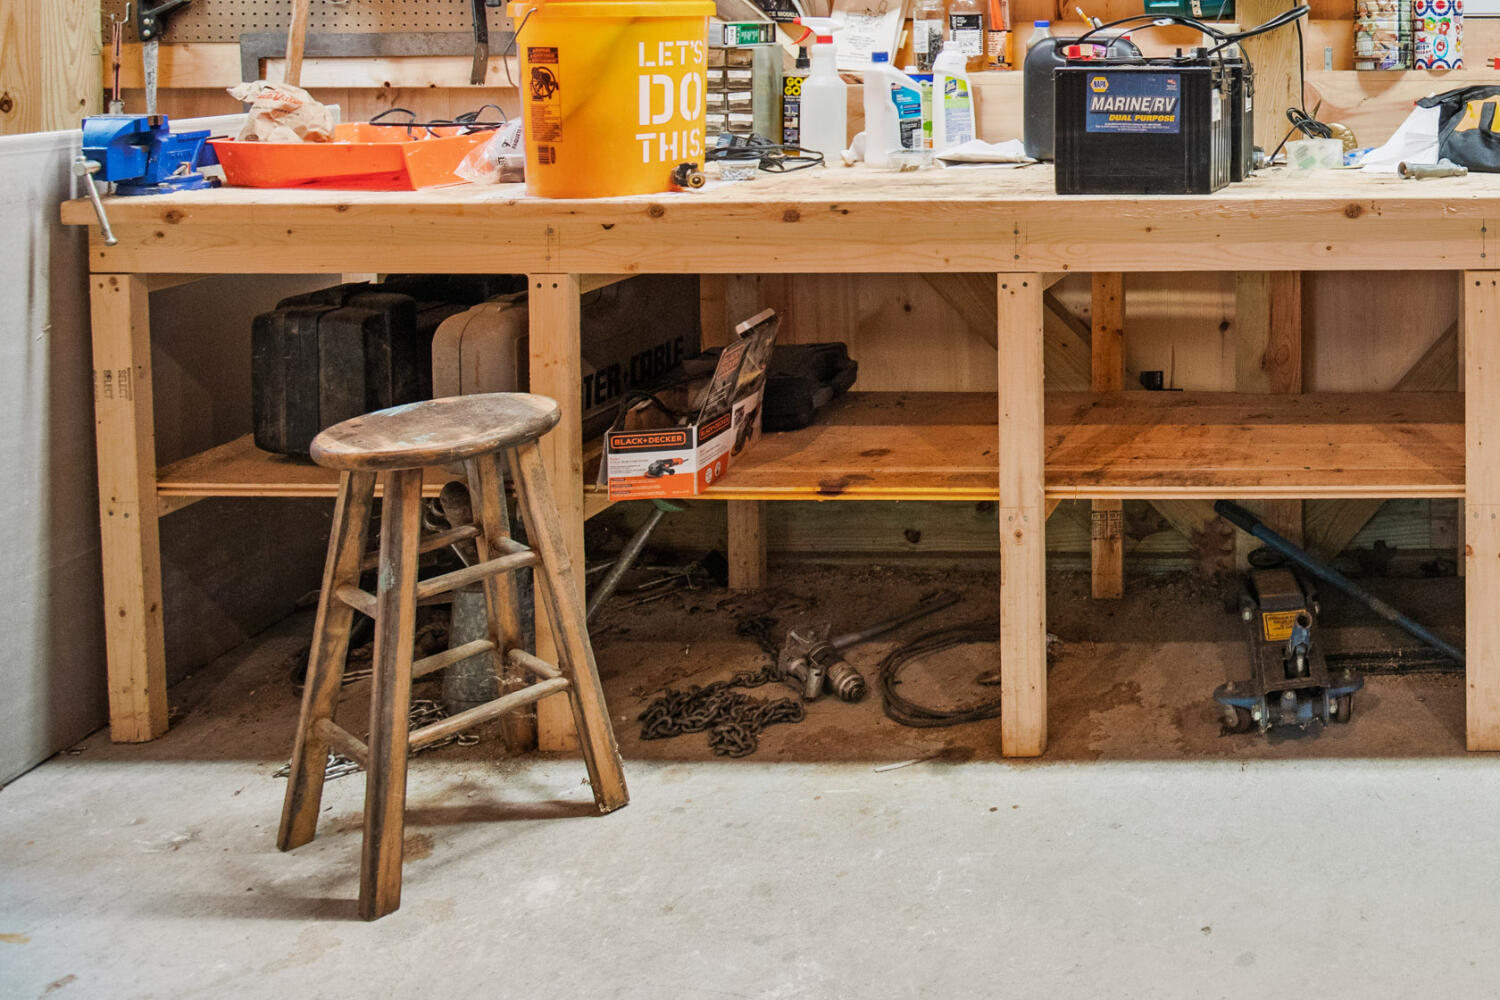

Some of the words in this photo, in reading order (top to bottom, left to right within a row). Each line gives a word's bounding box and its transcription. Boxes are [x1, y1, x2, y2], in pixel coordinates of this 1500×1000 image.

[638, 40, 704, 67] LET'S
[638, 71, 702, 126] DO
[1090, 96, 1176, 113] MARINE/RV
[1108, 114, 1132, 122] DUAL
[1134, 114, 1176, 122] PURPOSE
[636, 128, 704, 164] THIS.
[613, 435, 682, 447] BLACK+DECKER
